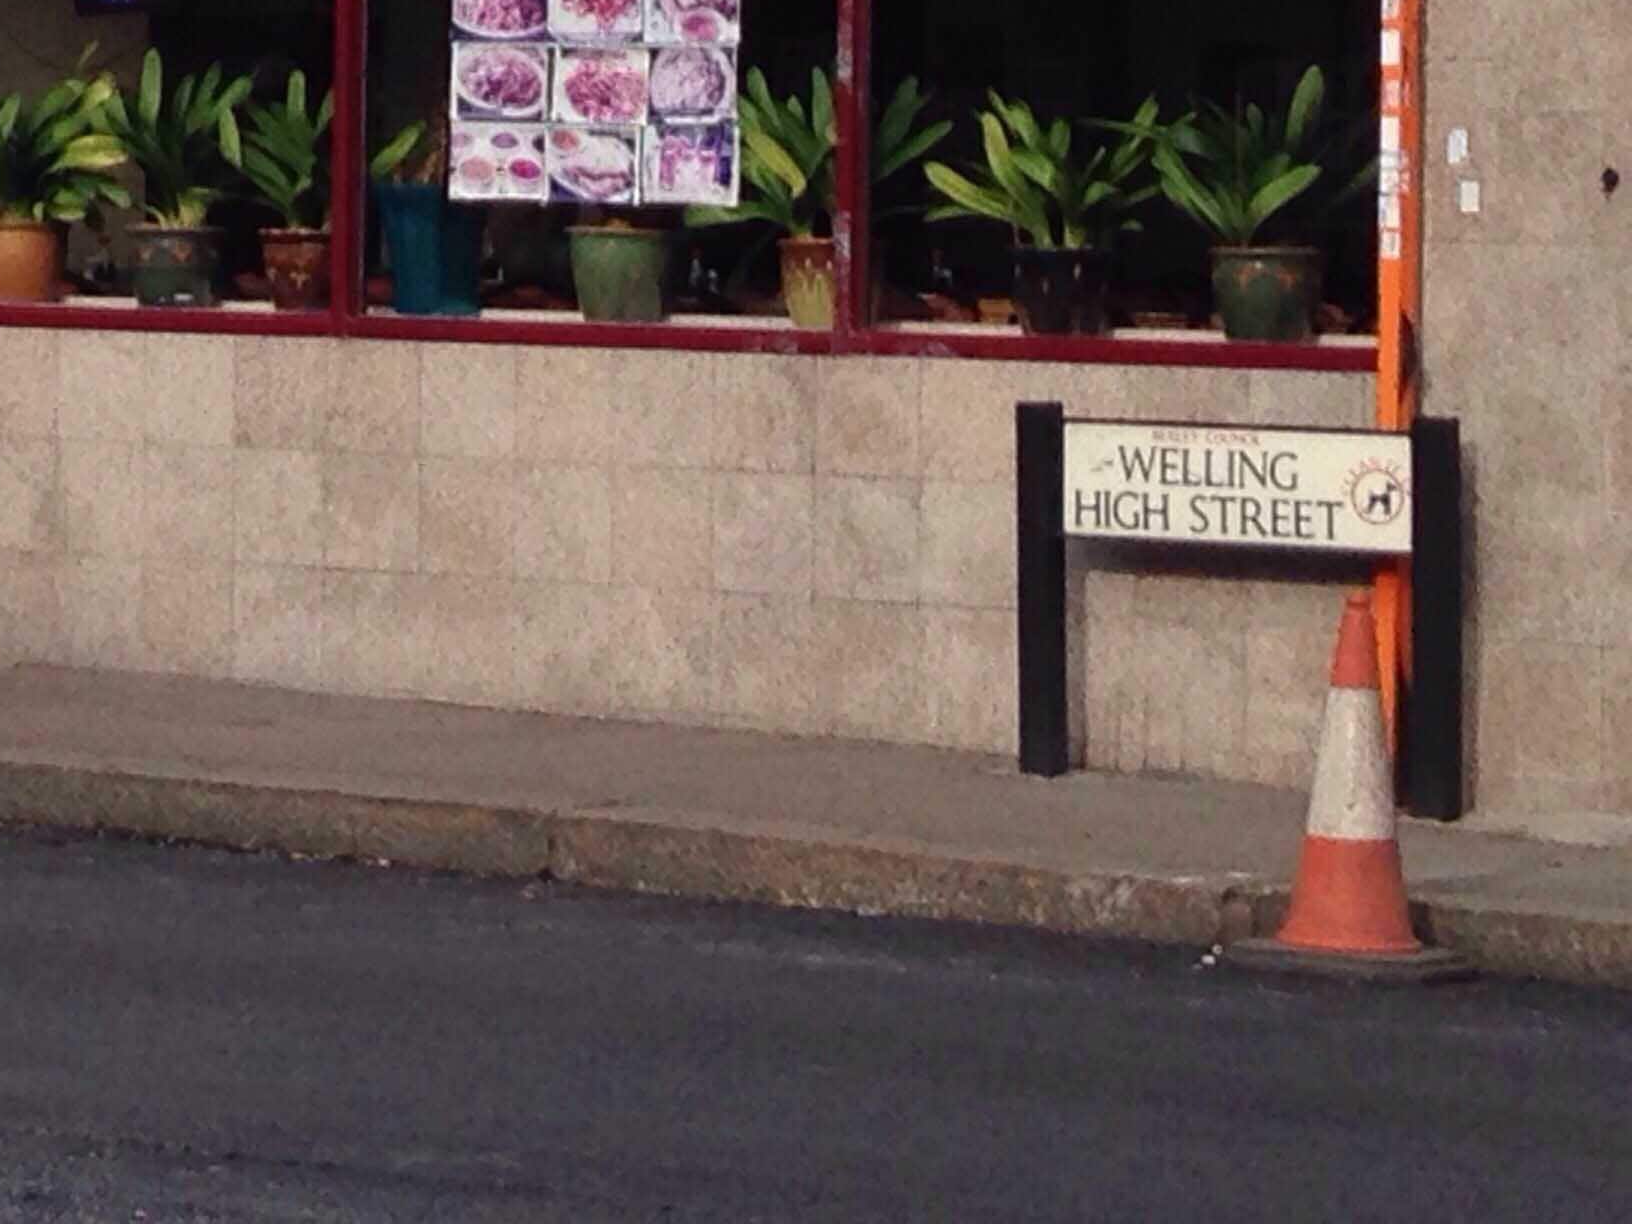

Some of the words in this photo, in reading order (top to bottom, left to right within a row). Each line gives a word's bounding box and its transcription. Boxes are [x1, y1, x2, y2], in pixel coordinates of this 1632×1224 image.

[1117, 445, 1300, 492] WELLING
[1073, 489, 1171, 532] HIGH
[1188, 494, 1344, 542] STREET
